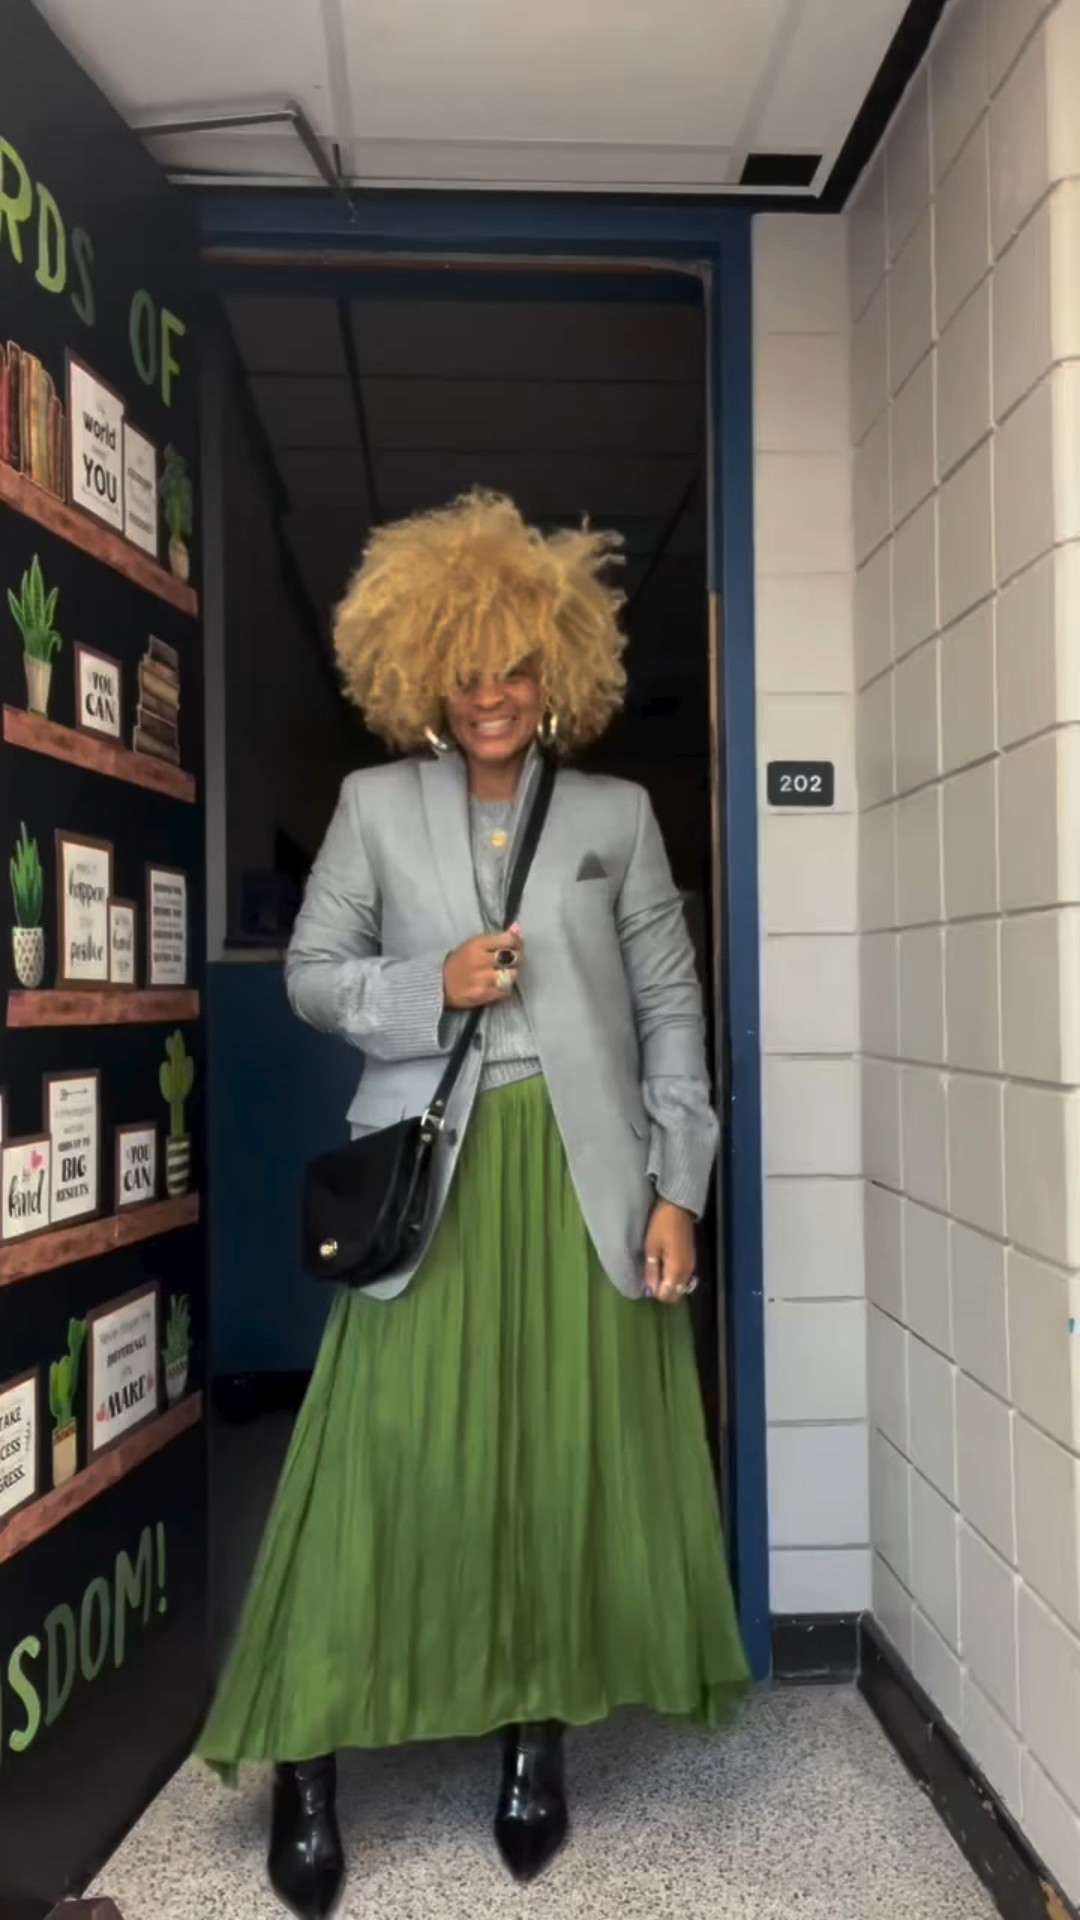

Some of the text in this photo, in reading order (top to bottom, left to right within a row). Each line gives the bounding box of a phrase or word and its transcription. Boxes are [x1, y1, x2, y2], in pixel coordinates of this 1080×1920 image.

[128, 288, 187, 408] OF
[82, 410, 117, 450] world
[82, 452, 118, 504] YOU
[91, 670, 113, 697] YOU
[85, 692, 116, 725] CAN
[779, 774, 823, 793] 202
[62, 1154, 86, 1183] BIG
[129, 1144, 151, 1165] YOU
[8, 1168, 45, 1218] kind
[56, 1183, 89, 1203] RESULTS
[123, 1165, 152, 1192] CAN
[108, 1373, 146, 1419] MAKE
[0, 1521, 167, 1768] SDOM!
